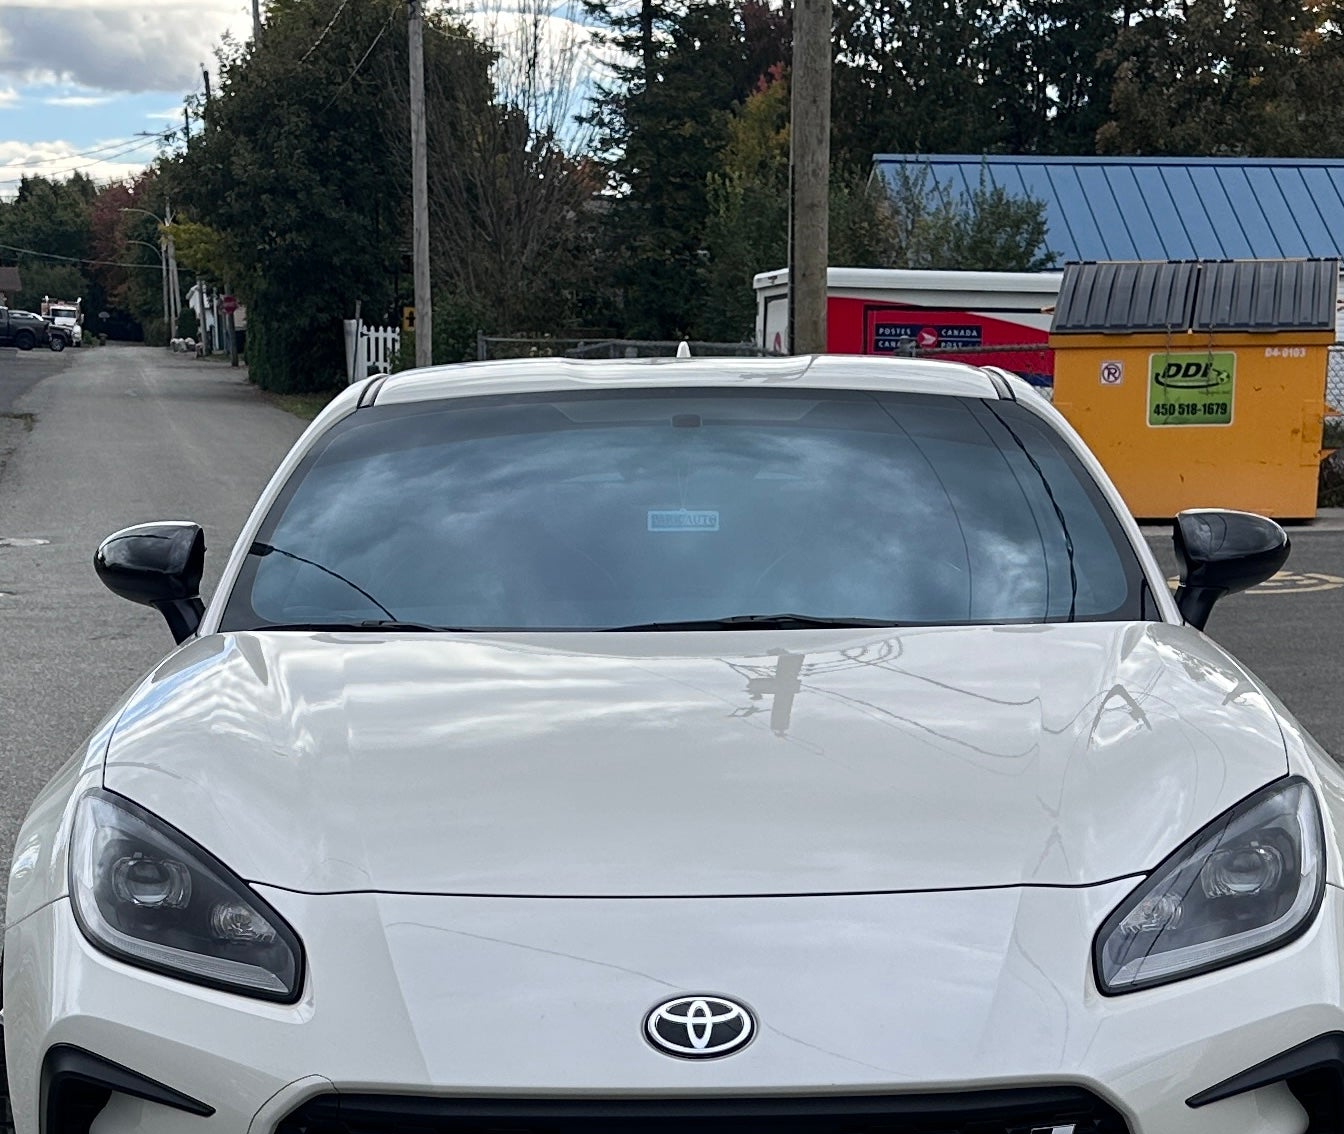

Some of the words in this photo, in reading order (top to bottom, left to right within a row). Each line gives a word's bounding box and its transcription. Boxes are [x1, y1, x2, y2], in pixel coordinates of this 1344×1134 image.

[941, 329, 978, 337] CANADA
[1162, 362, 1212, 379] DDI
[1153, 403, 1176, 416] 450
[1177, 402, 1228, 416] 518-1679
